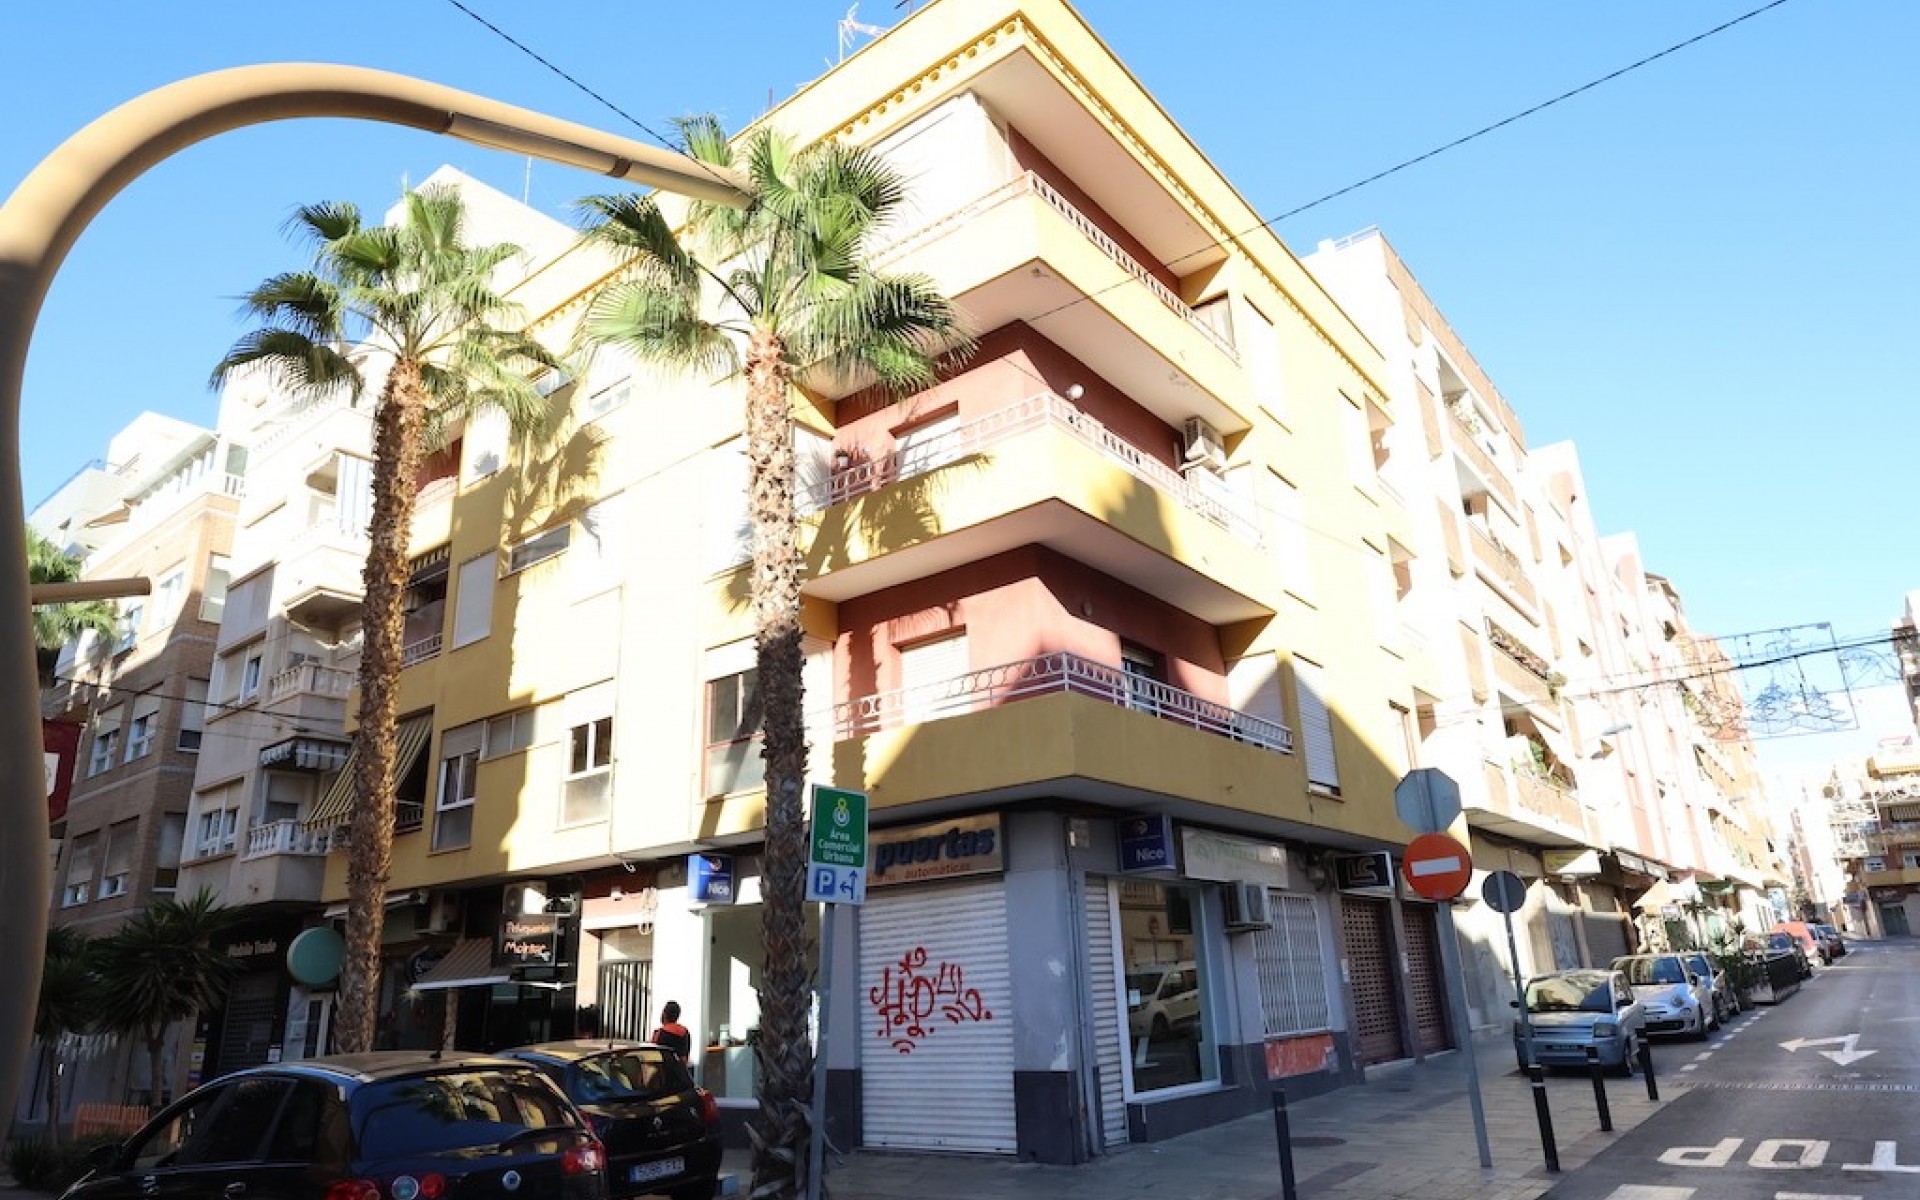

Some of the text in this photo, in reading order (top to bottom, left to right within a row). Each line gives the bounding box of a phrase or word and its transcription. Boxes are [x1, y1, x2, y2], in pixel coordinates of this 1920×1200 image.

[818, 838, 861, 853] Comercial
[874, 827, 995, 876] puertas
[822, 849, 854, 864] Urbana
[1135, 847, 1166, 863] Nice
[818, 869, 834, 894] P
